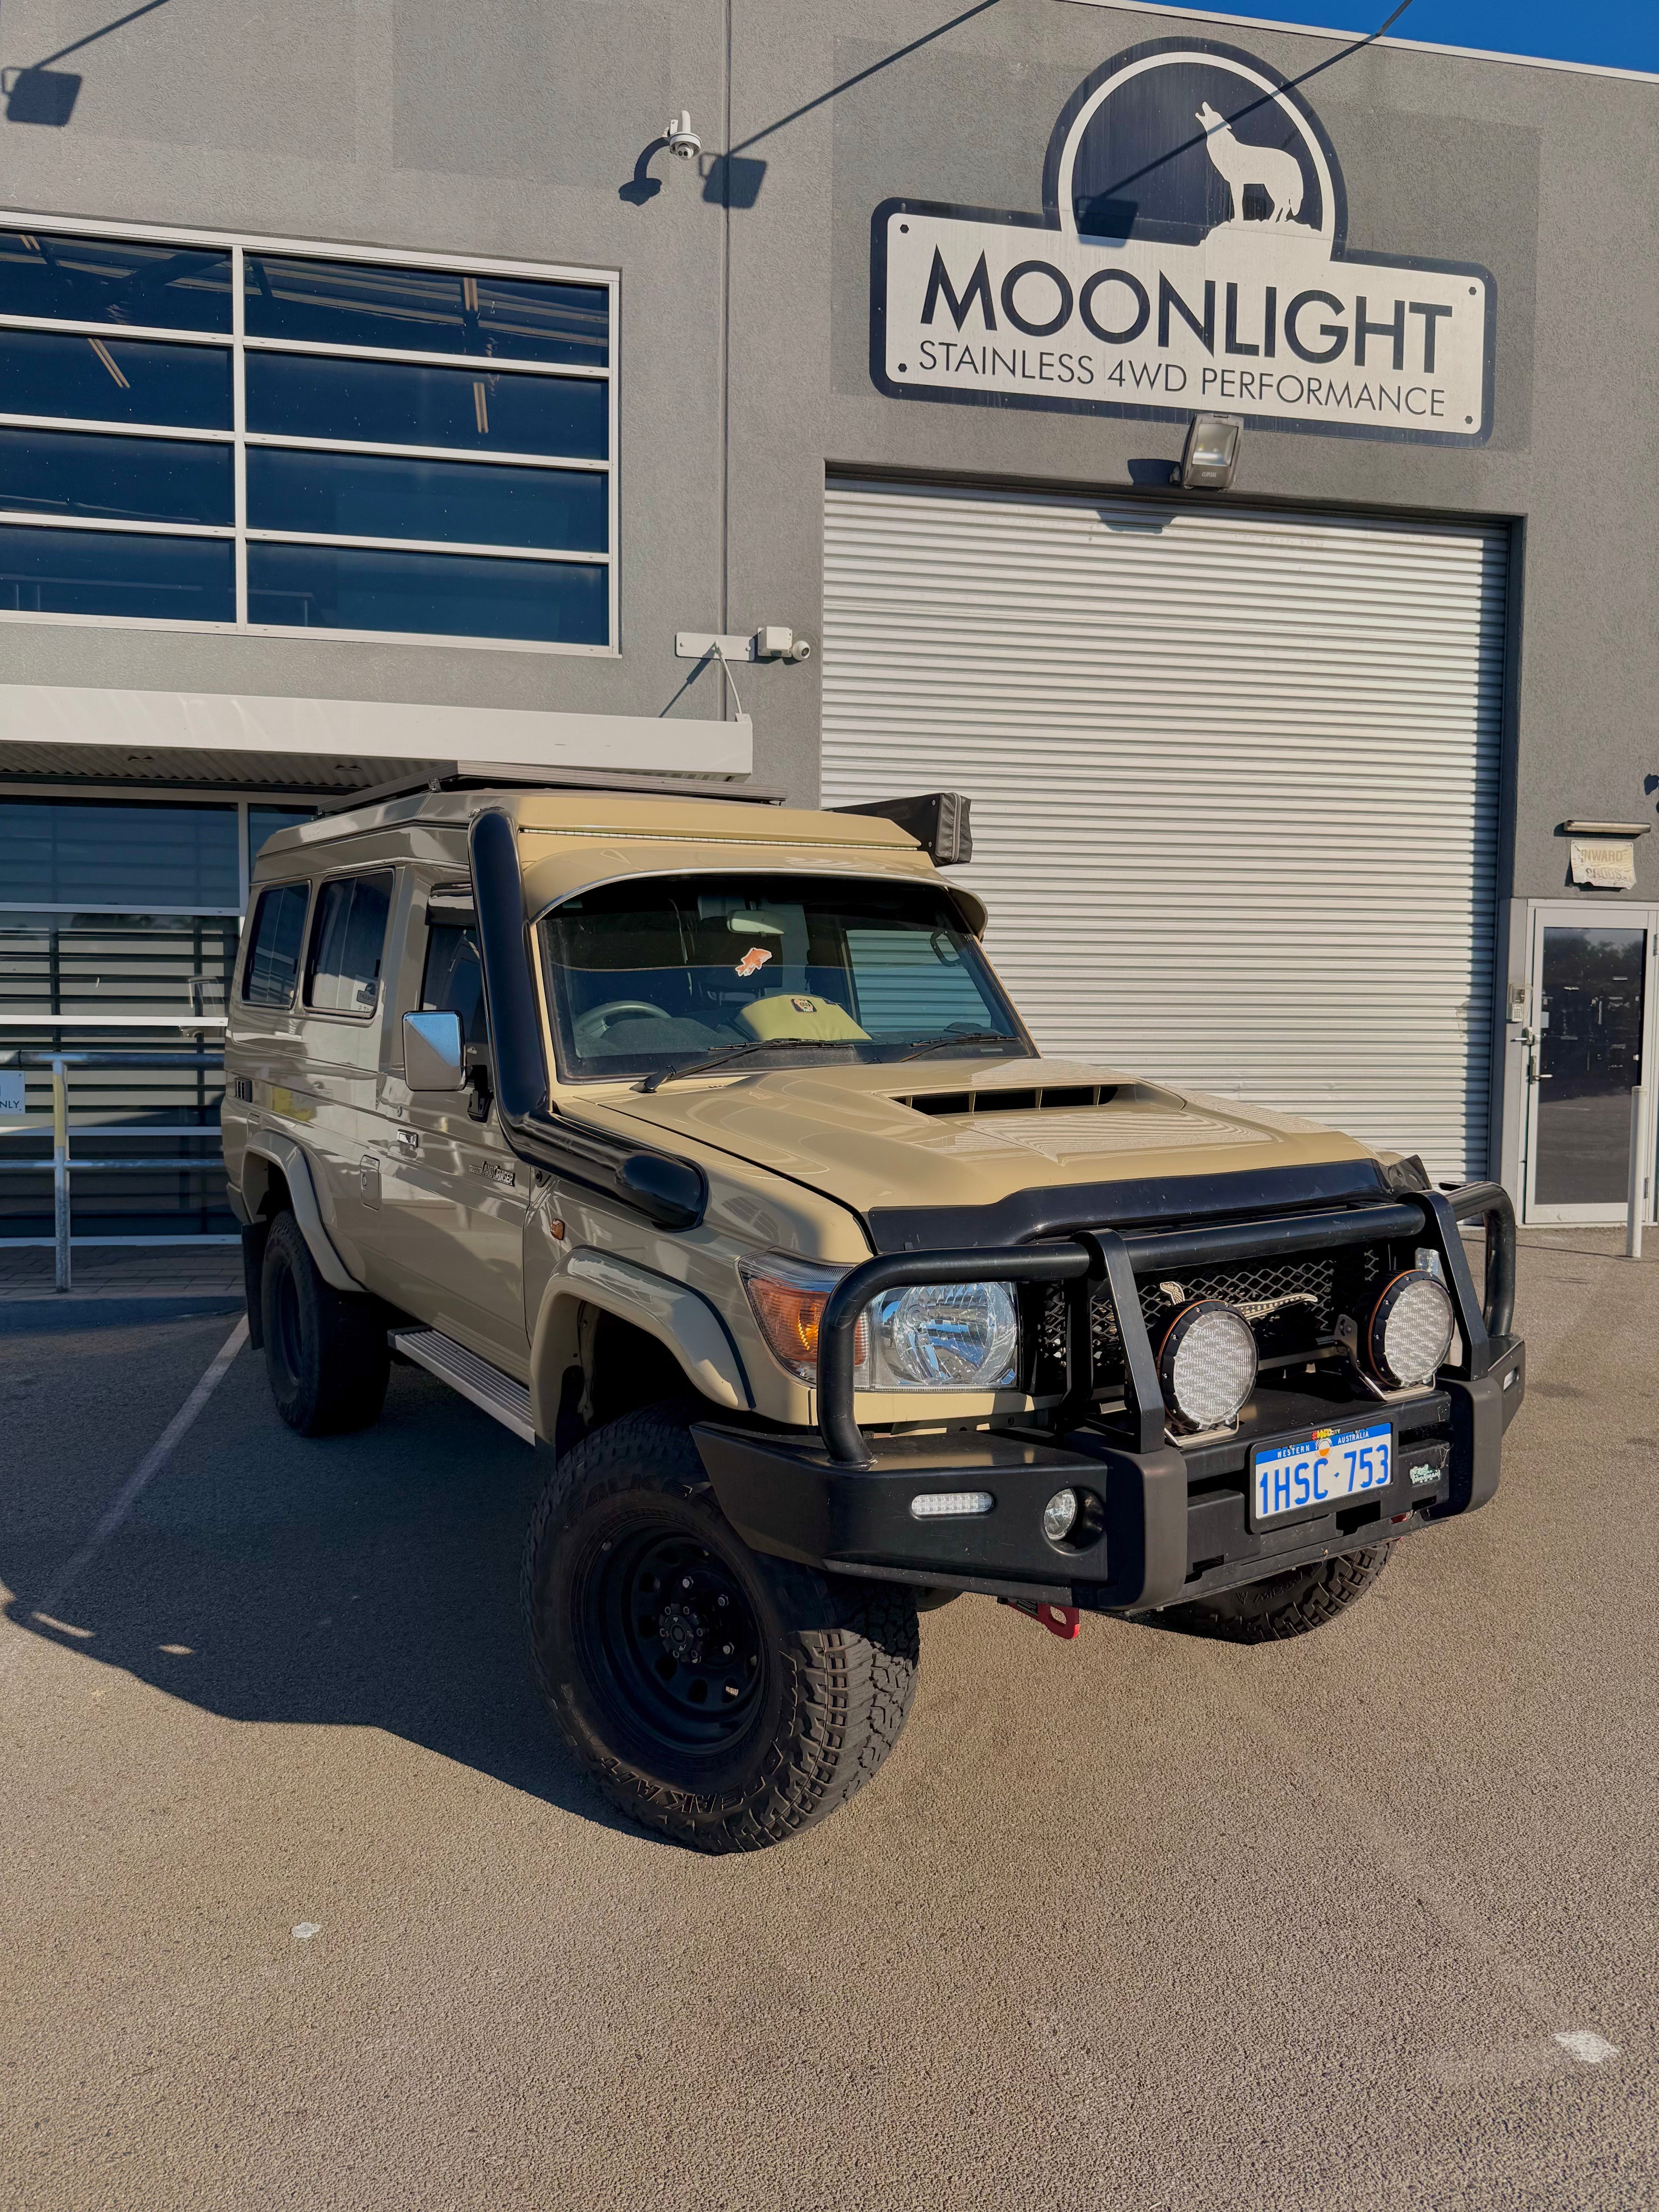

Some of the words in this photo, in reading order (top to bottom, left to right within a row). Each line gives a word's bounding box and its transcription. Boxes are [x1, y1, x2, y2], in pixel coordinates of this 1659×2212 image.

[920, 243, 1453, 374] MOONLIGHT
[919, 340, 1094, 385] STAINLESS
[1107, 359, 1187, 392] 4WD
[1202, 367, 1445, 417] PERFORMANCE
[1277, 1444, 1310, 1458] WESTERN
[1338, 1431, 1369, 1444] AUSTRALIA
